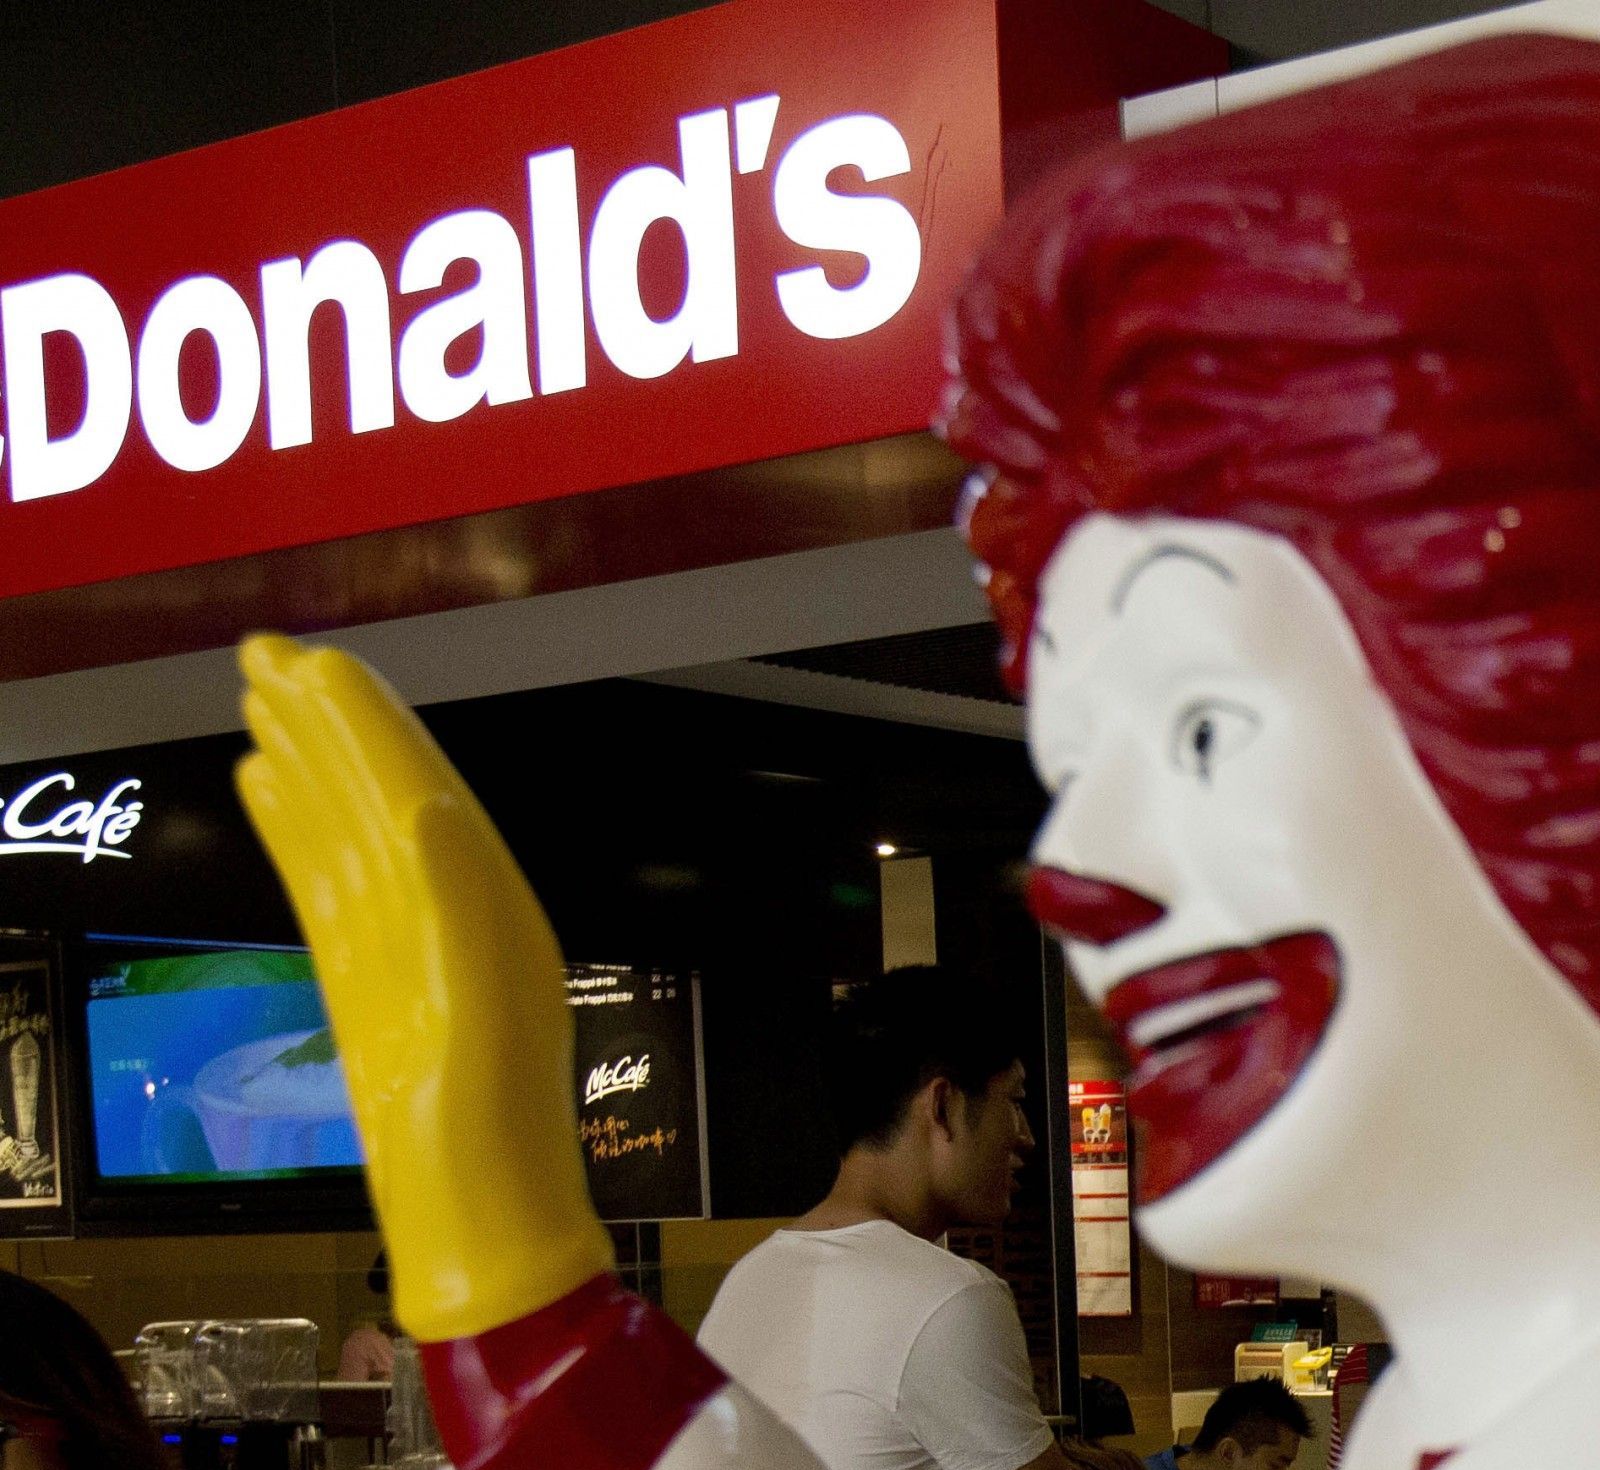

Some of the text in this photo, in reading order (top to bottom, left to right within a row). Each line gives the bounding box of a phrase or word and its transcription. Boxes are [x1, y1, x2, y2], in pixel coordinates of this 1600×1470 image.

[0, 94, 923, 503] Donald's
[0, 772, 144, 864] Café
[585, 1054, 650, 1103] McCafé
